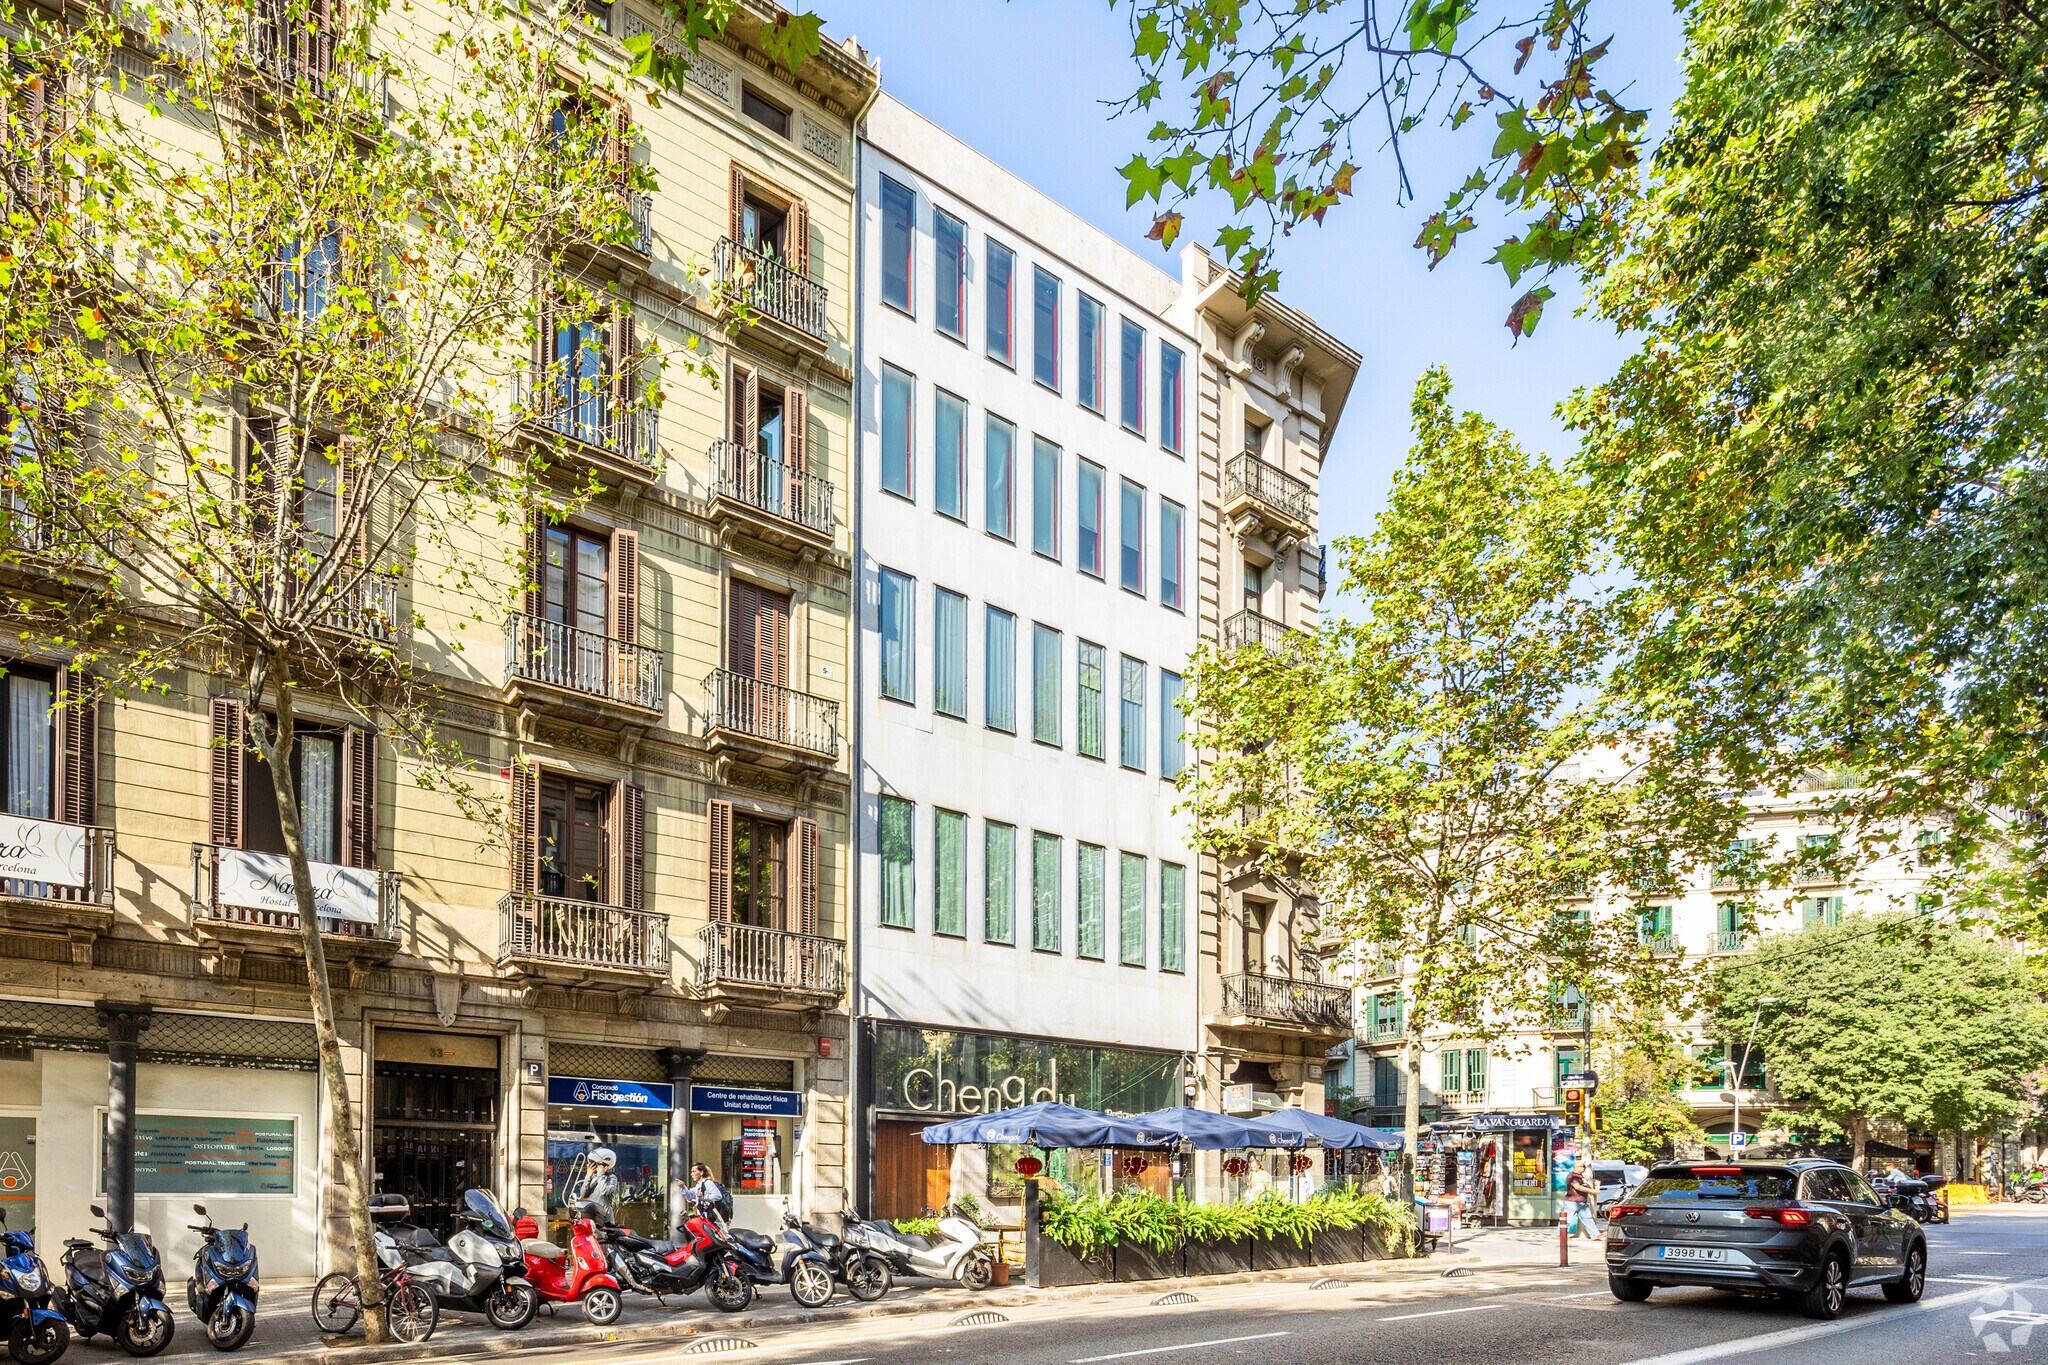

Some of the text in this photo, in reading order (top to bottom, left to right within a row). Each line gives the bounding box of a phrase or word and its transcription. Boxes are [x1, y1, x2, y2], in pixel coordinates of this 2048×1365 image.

[250, 873, 334, 900] Nara
[260, 896, 292, 907] Hostal
[429, 1048, 444, 1058] 33
[530, 1064, 539, 1075] P
[592, 1083, 619, 1095] Corporació
[592, 1091, 648, 1104] Fisiogestión
[707, 1091, 728, 1099] Centre
[729, 1092, 737, 1100] de
[738, 1093, 772, 1102] rehabilitació
[724, 1101, 742, 1109] Unitat
[751, 1102, 773, 1111] l'esport
[1489, 1118, 1556, 1127] VANGUARDIA
[1732, 1134, 1744, 1145] P
[1667, 1248, 1722, 1260] 3998 LWJ
